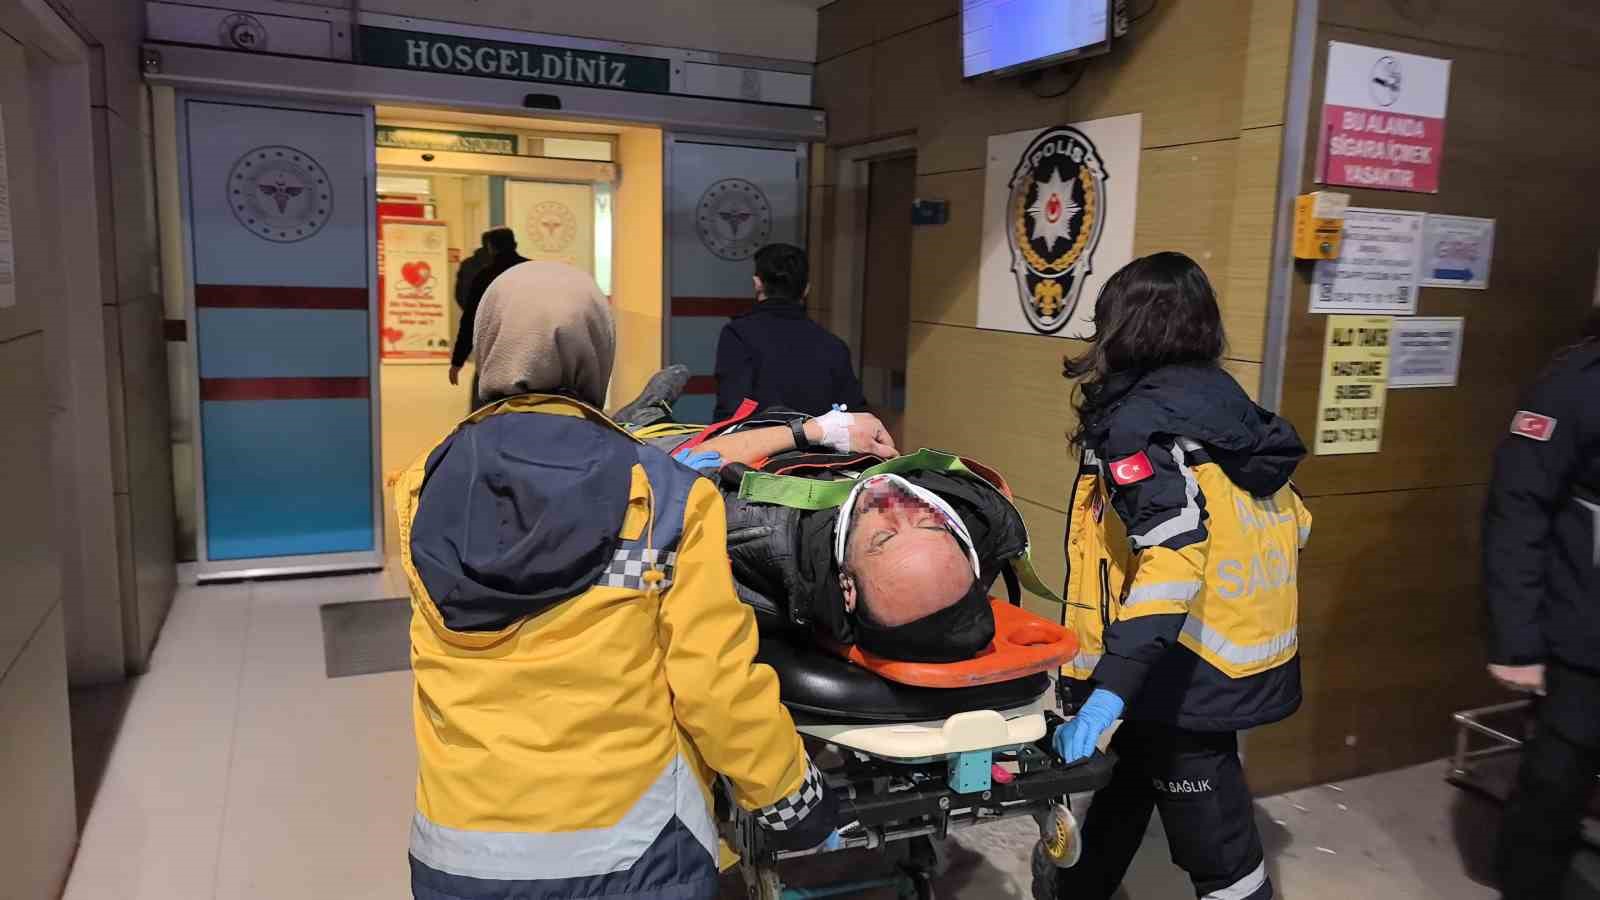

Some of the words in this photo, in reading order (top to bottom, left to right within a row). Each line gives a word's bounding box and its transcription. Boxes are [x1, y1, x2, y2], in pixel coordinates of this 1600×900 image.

[405, 39, 627, 88] HOŞGELDİNİZ
[1032, 138, 1085, 167] POLİS
[1168, 778, 1212, 793] SAĞLIK
